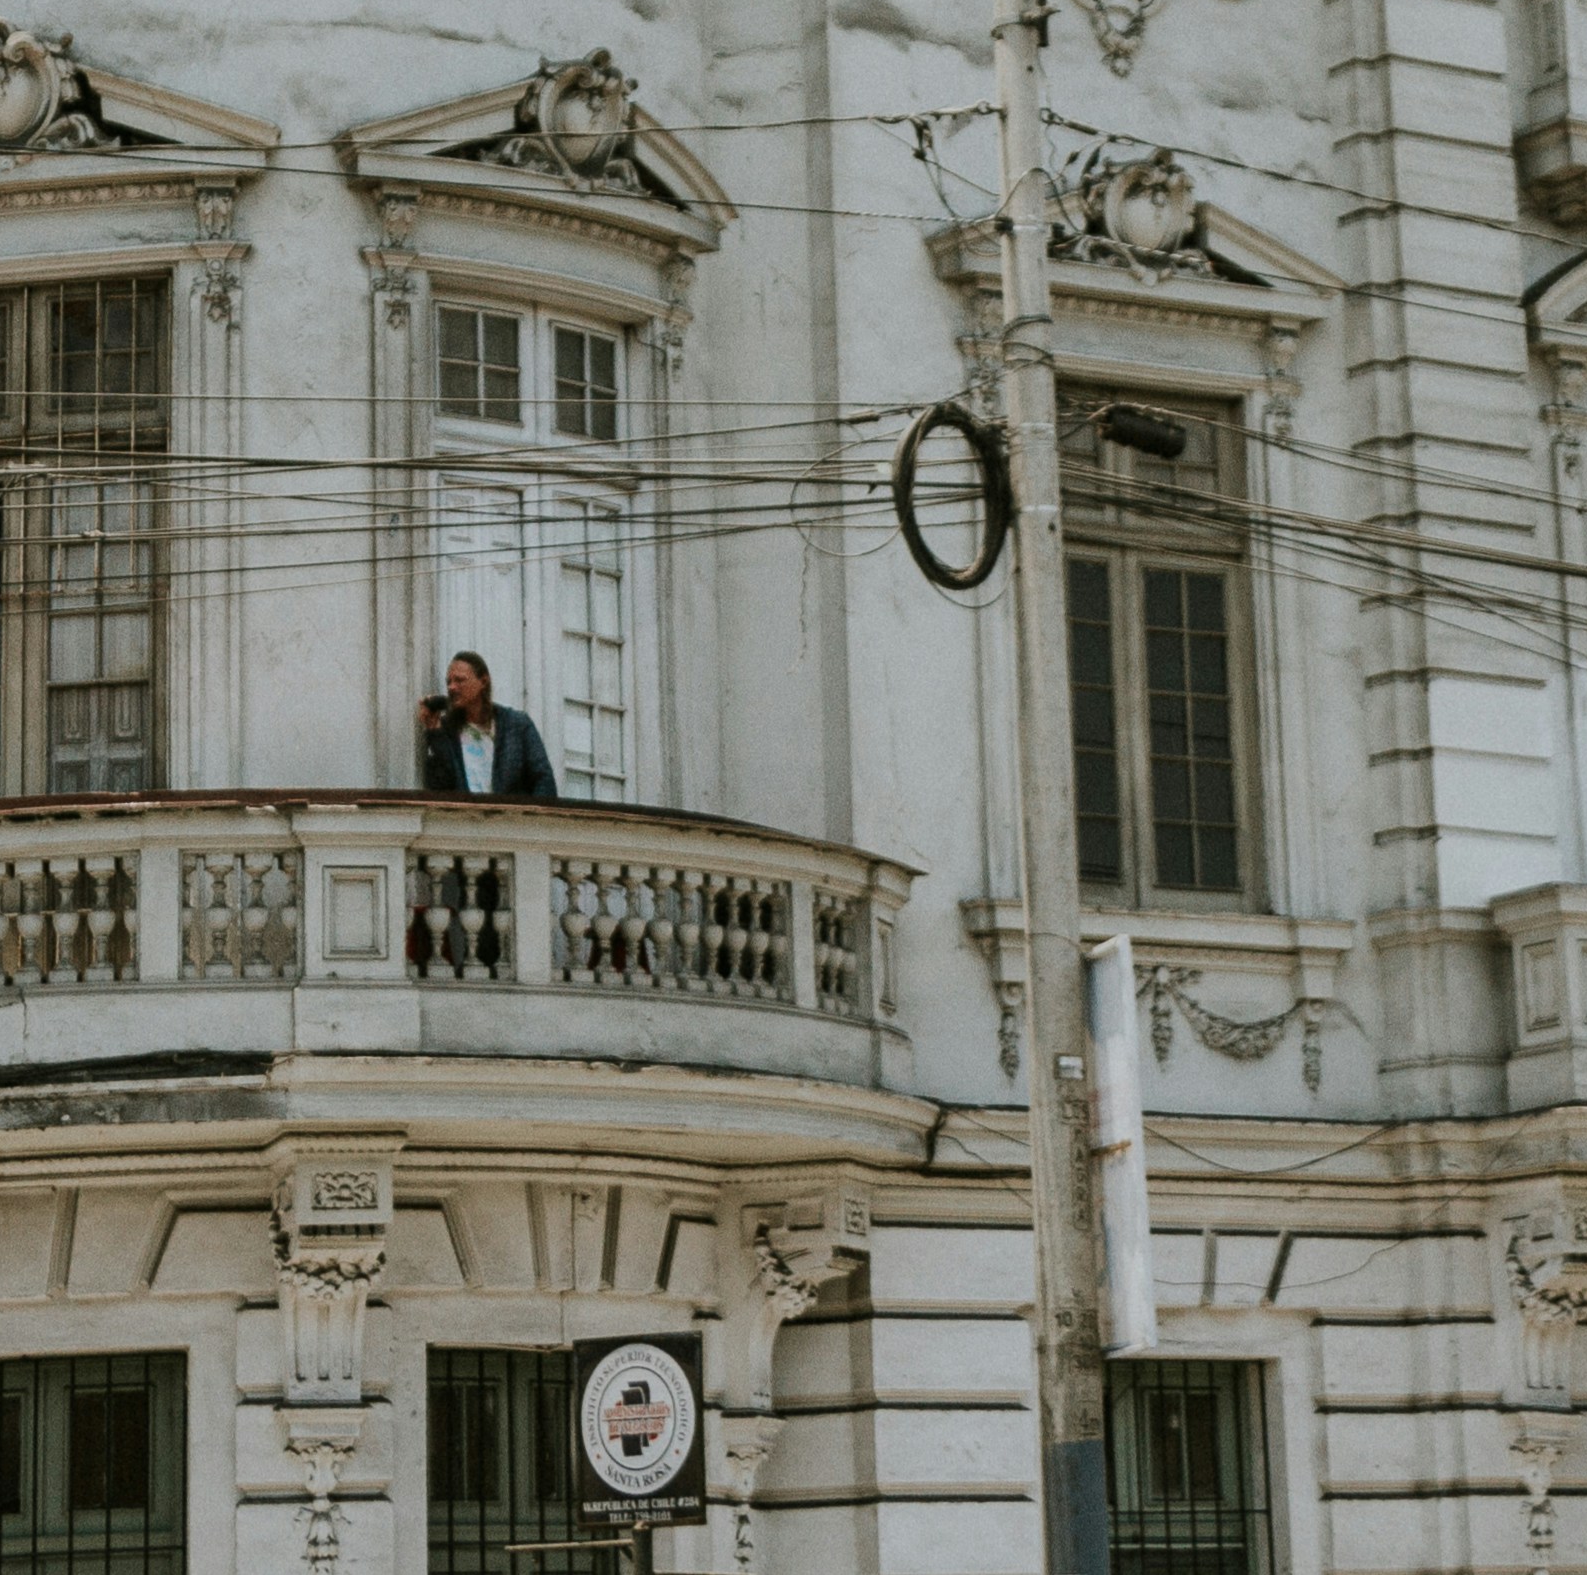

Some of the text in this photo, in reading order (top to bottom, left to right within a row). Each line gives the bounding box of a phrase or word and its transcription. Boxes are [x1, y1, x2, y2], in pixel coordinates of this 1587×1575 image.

[605, 1463, 673, 1488] SANTA ROSA
[638, 1499, 649, 1509] DE
[651, 1498, 675, 1508] CHILE
